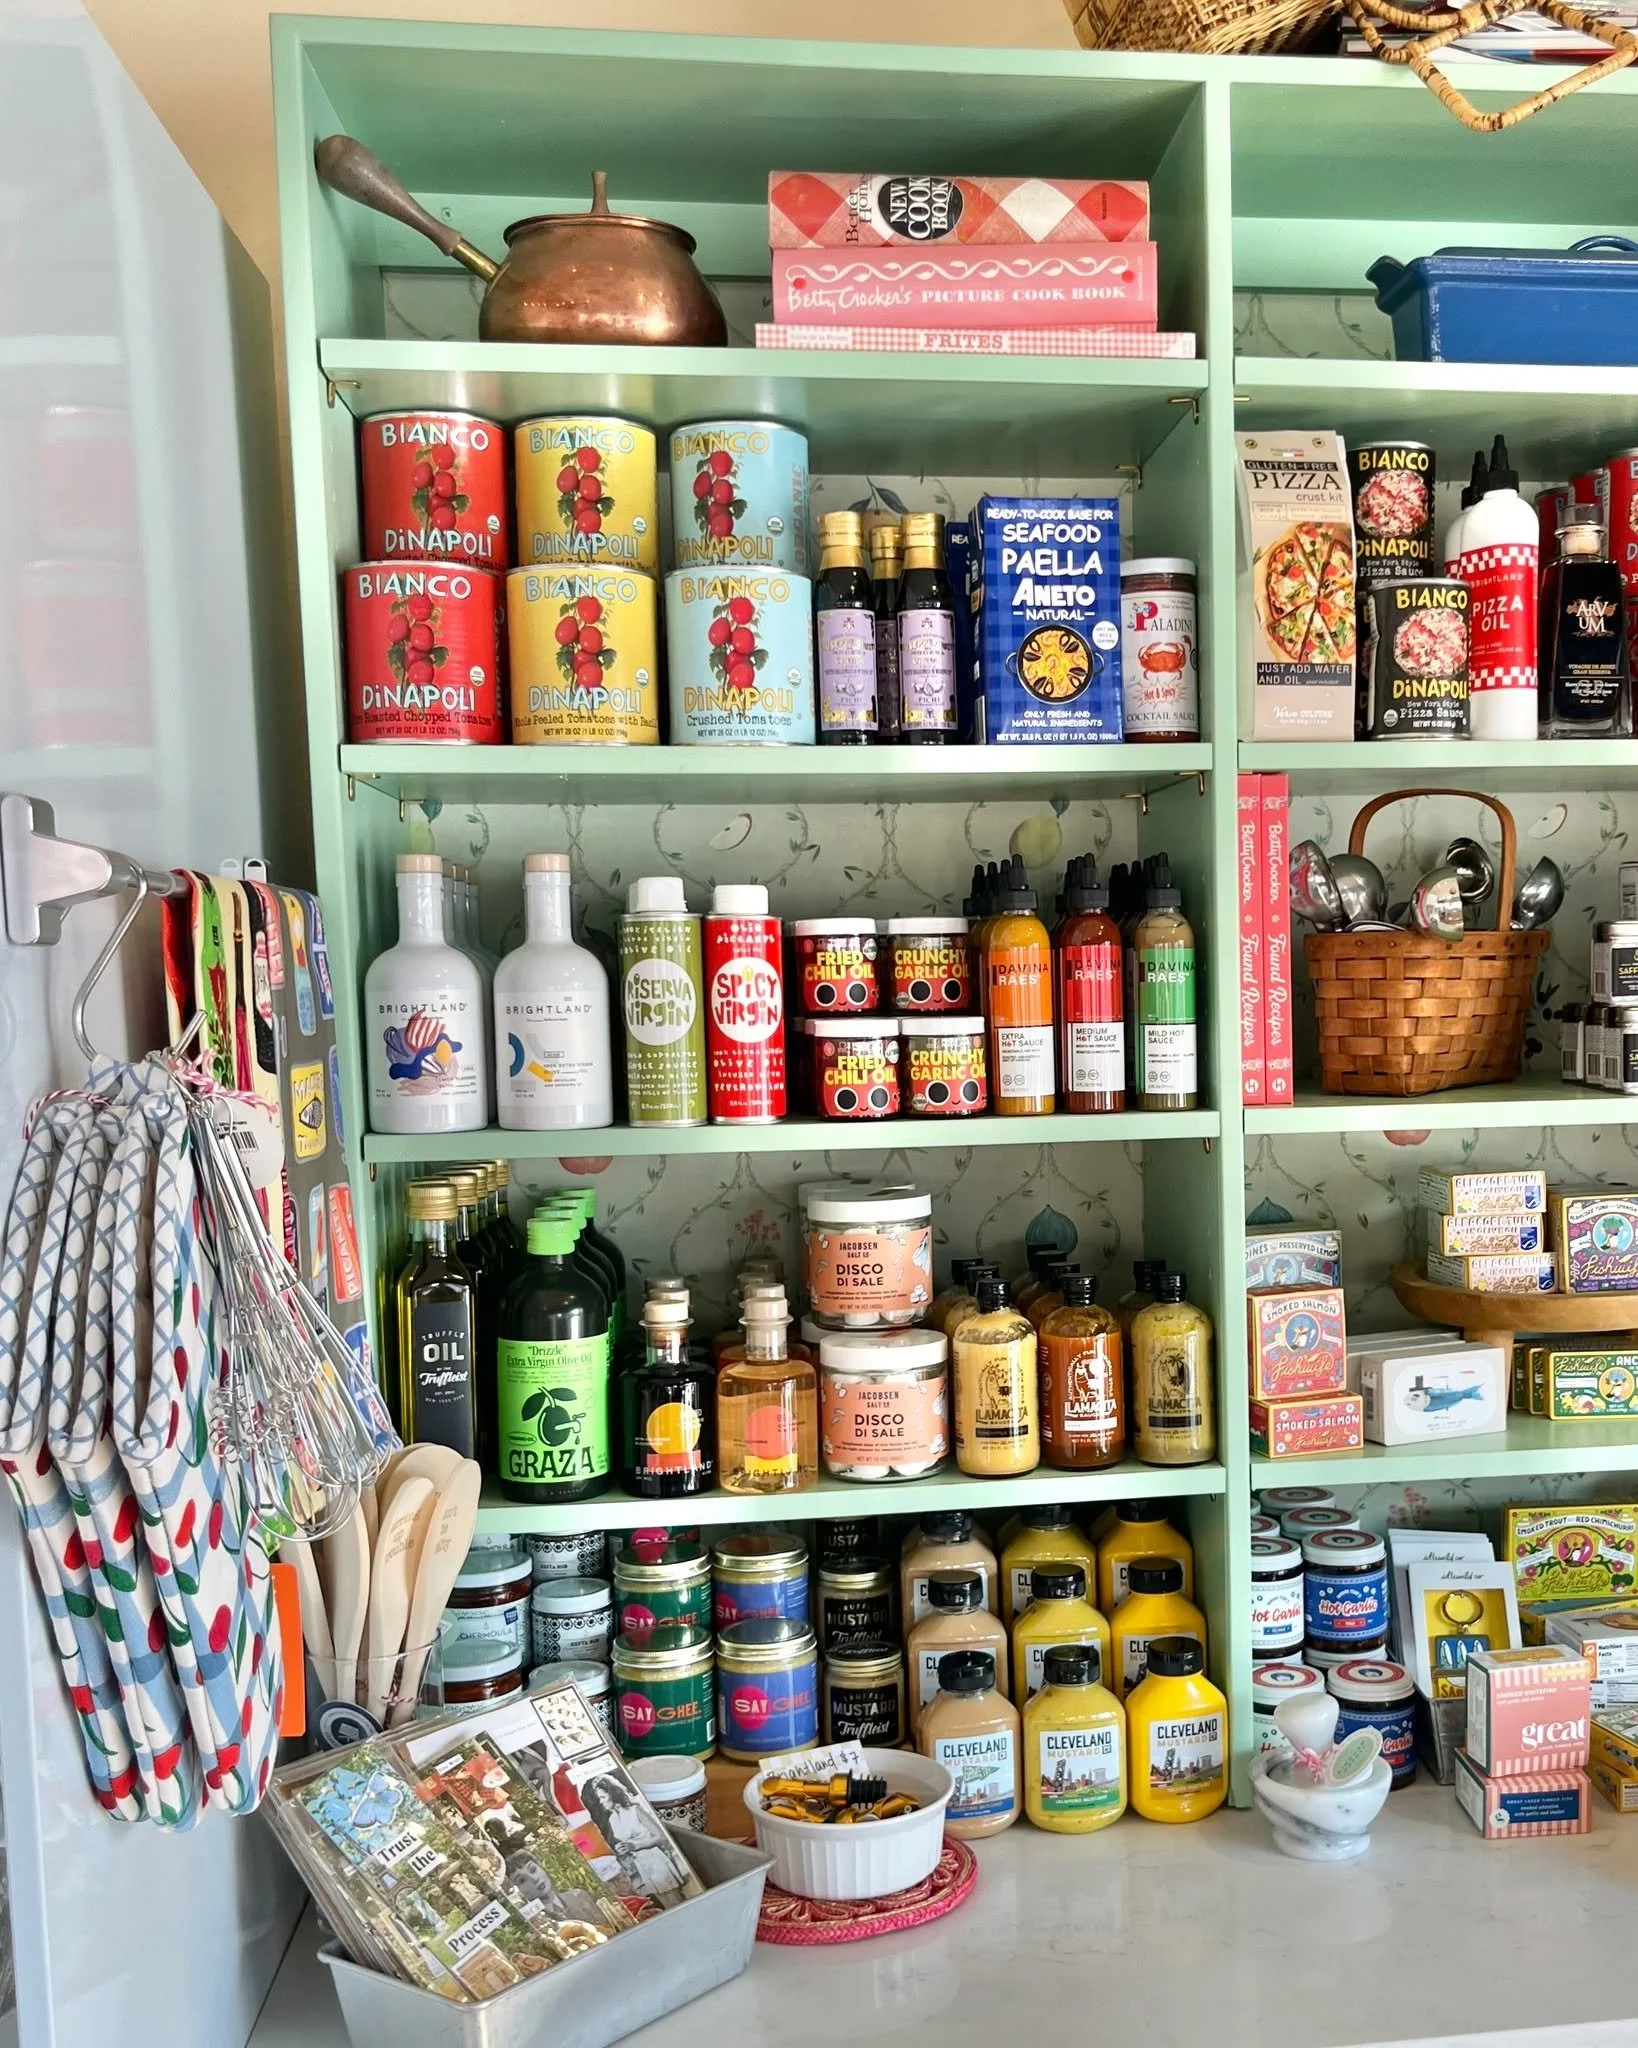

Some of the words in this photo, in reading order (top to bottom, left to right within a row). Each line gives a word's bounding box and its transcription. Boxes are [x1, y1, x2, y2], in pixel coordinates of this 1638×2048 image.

[890, 182, 908, 223] NEW
[908, 176, 930, 239] COOK
[932, 181, 948, 231] BOOK
[787, 286, 837, 315] Betty
[837, 284, 913, 310] Crocker's
[921, 289, 1005, 304] PICTURE
[1012, 288, 1066, 301] COOK
[1071, 286, 1126, 300] BOOK
[923, 333, 1004, 349] FRITES
[381, 422, 489, 451] BIANCO
[530, 426, 635, 454] BIANCO
[673, 429, 769, 461] BIANCO
[1247, 462, 1336, 471] GLUTEN-FREE
[1358, 451, 1429, 471] BIANCO
[1250, 472, 1342, 490] PIZZA
[1296, 494, 1326, 502] crust
[1329, 492, 1344, 502] kit
[987, 508, 1066, 520] READY-TO-COOK
[1067, 509, 1093, 520] BASE
[1094, 510, 1113, 520] FOR
[1002, 523, 1102, 543] SEAFOOD
[385, 529, 492, 558] DiNAPOLI
[533, 532, 639, 559] DiNAPOLI
[677, 535, 774, 562] DiNAPOLI
[1356, 539, 1429, 558] DiNAPOLI
[1002, 548, 1103, 576] PAELLA
[1360, 566, 1391, 577] Pizza
[1395, 567, 1424, 577] Sauce
[359, 573, 472, 600] BIANCO
[525, 575, 637, 601] BIANCO
[680, 576, 790, 604] BIANCO
[1012, 578, 1096, 611] ANETO
[1396, 590, 1468, 610] BIANCO
[1472, 595, 1524, 616] PIZZA
[1026, 609, 1085, 621] NATURAL
[1481, 615, 1510, 632] OIL
[1579, 616, 1607, 633] UM
[1259, 664, 1286, 673] JUST
[1289, 665, 1311, 674] ADD
[1314, 665, 1349, 674] WATER
[1259, 676, 1280, 684] AND
[1284, 676, 1302, 684] OIL
[362, 683, 476, 711] DiNAPOLI
[1144, 687, 1156, 700] Hot
[1162, 686, 1177, 700] Spicy
[1393, 679, 1467, 700] DiNAPOLI
[528, 686, 641, 713] DiNAPOLI
[683, 687, 793, 714] DiNAPOLI
[567, 714, 615, 724] Tomatoes
[686, 714, 732, 727] Crushed
[736, 714, 792, 726] Tomatoes
[1127, 711, 1170, 722] COCKTAIL
[1400, 707, 1433, 718] Pizza
[1437, 708, 1465, 718] Sauce
[1049, 719, 1103, 727] INGREDIENTS
[1241, 821, 1256, 858] Betty
[1268, 821, 1283, 858] Betty
[1241, 856, 1256, 904] Crocker
[1268, 856, 1284, 904] Crocker
[816, 951, 864, 966] FRIED
[894, 949, 967, 965] CRUNCHY
[1240, 933, 1259, 983] Found
[1268, 933, 1287, 983] Found
[804, 964, 847, 980] CHILI
[850, 963, 874, 979] OIL
[894, 966, 949, 979] GARLIC
[951, 965, 969, 978] OIL
[999, 964, 1049, 974] DAVINA
[1074, 970, 1113, 981] RAES
[1148, 962, 1195, 972] DAVINA
[717, 966, 778, 999] SPiCY
[999, 974, 1038, 985] RAES
[1147, 972, 1186, 983] RAES
[627, 973, 692, 1001] RiSERVA
[379, 1003, 466, 1014] BRIGHTLAND
[505, 1004, 592, 1014] BRIGHTLAND
[627, 1000, 691, 1027] ViRgiN
[715, 1000, 779, 1026] ViRgiN
[1241, 986, 1260, 1047] Recipes
[1268, 986, 1288, 1047] Recipes
[1076, 1027, 1108, 1035] MEDIUM
[1018, 1039, 1044, 1047] SAUCE
[838, 1055, 886, 1070] FRIED
[910, 1048, 984, 1066] CRUNCHY
[825, 1068, 869, 1084] CHILI
[872, 1067, 897, 1083] OIL
[910, 1065, 967, 1080] GARLIC
[969, 1064, 985, 1080] OIL
[839, 1241, 878, 1251] JACOBSEN
[1279, 1241, 1316, 1251] PRESERVED
[1316, 1245, 1339, 1257] LEMON
[836, 1263, 884, 1275] DISCO
[837, 1277, 849, 1287] DI
[852, 1276, 884, 1287] SALE
[1267, 1301, 1300, 1321] SMOKED
[1302, 1300, 1337, 1315] SALMON
[421, 1330, 465, 1341] TRUFFLE
[423, 1342, 465, 1362] OIL
[507, 1354, 527, 1367] Extra
[527, 1355, 555, 1368] Virgin
[557, 1354, 578, 1364] Olive
[580, 1352, 593, 1364] Oil
[1271, 1350, 1334, 1382] Fishwife
[1554, 1356, 1607, 1375] Fishwife
[419, 1370, 469, 1387] Truffleist
[858, 1391, 899, 1400] JACOBSEN
[854, 1413, 904, 1426] DISCO
[976, 1406, 1028, 1424] LLAMACTA
[1275, 1420, 1316, 1433] SMOKED
[1317, 1413, 1360, 1429] SALMON
[855, 1428, 867, 1437] DI
[872, 1427, 905, 1437] SALE
[1293, 1430, 1341, 1450] Fishwife
[509, 1446, 596, 1478] GRAZA
[635, 1461, 712, 1477] BRIGHTLND
[1517, 1522, 1545, 1535] SMOKED
[1545, 1517, 1568, 1527] TROUT
[1576, 1515, 1590, 1523] RED
[1591, 1516, 1635, 1531] CHIMICHURRI
[716, 1604, 738, 1620] SAY
[1320, 1601, 1341, 1615] Hot
[624, 1618, 654, 1630] SAY
[459, 1628, 513, 1640] CHERMOULA
[622, 1705, 652, 1721] SAY
[656, 1701, 699, 1720] GHEE
[734, 1698, 768, 1713] SAY
[772, 1691, 810, 1711] GHEE
[833, 1701, 896, 1717] MUSTARD
[1157, 1718, 1218, 1740] CLEVELAND
[1521, 1715, 1587, 1752] great
[943, 1737, 1008, 1758] CLEVELAND
[1047, 1731, 1112, 1750] CLEVELAND
[1157, 1735, 1209, 1747] MUSTARD
[839, 1749, 860, 1765] $7
[943, 1753, 998, 1768] MUSTARD
[1047, 1747, 1101, 1758] MUSTARD
[376, 1832, 418, 1863] Trust
[411, 1849, 436, 1872] the
[447, 1906, 501, 1954] Process
